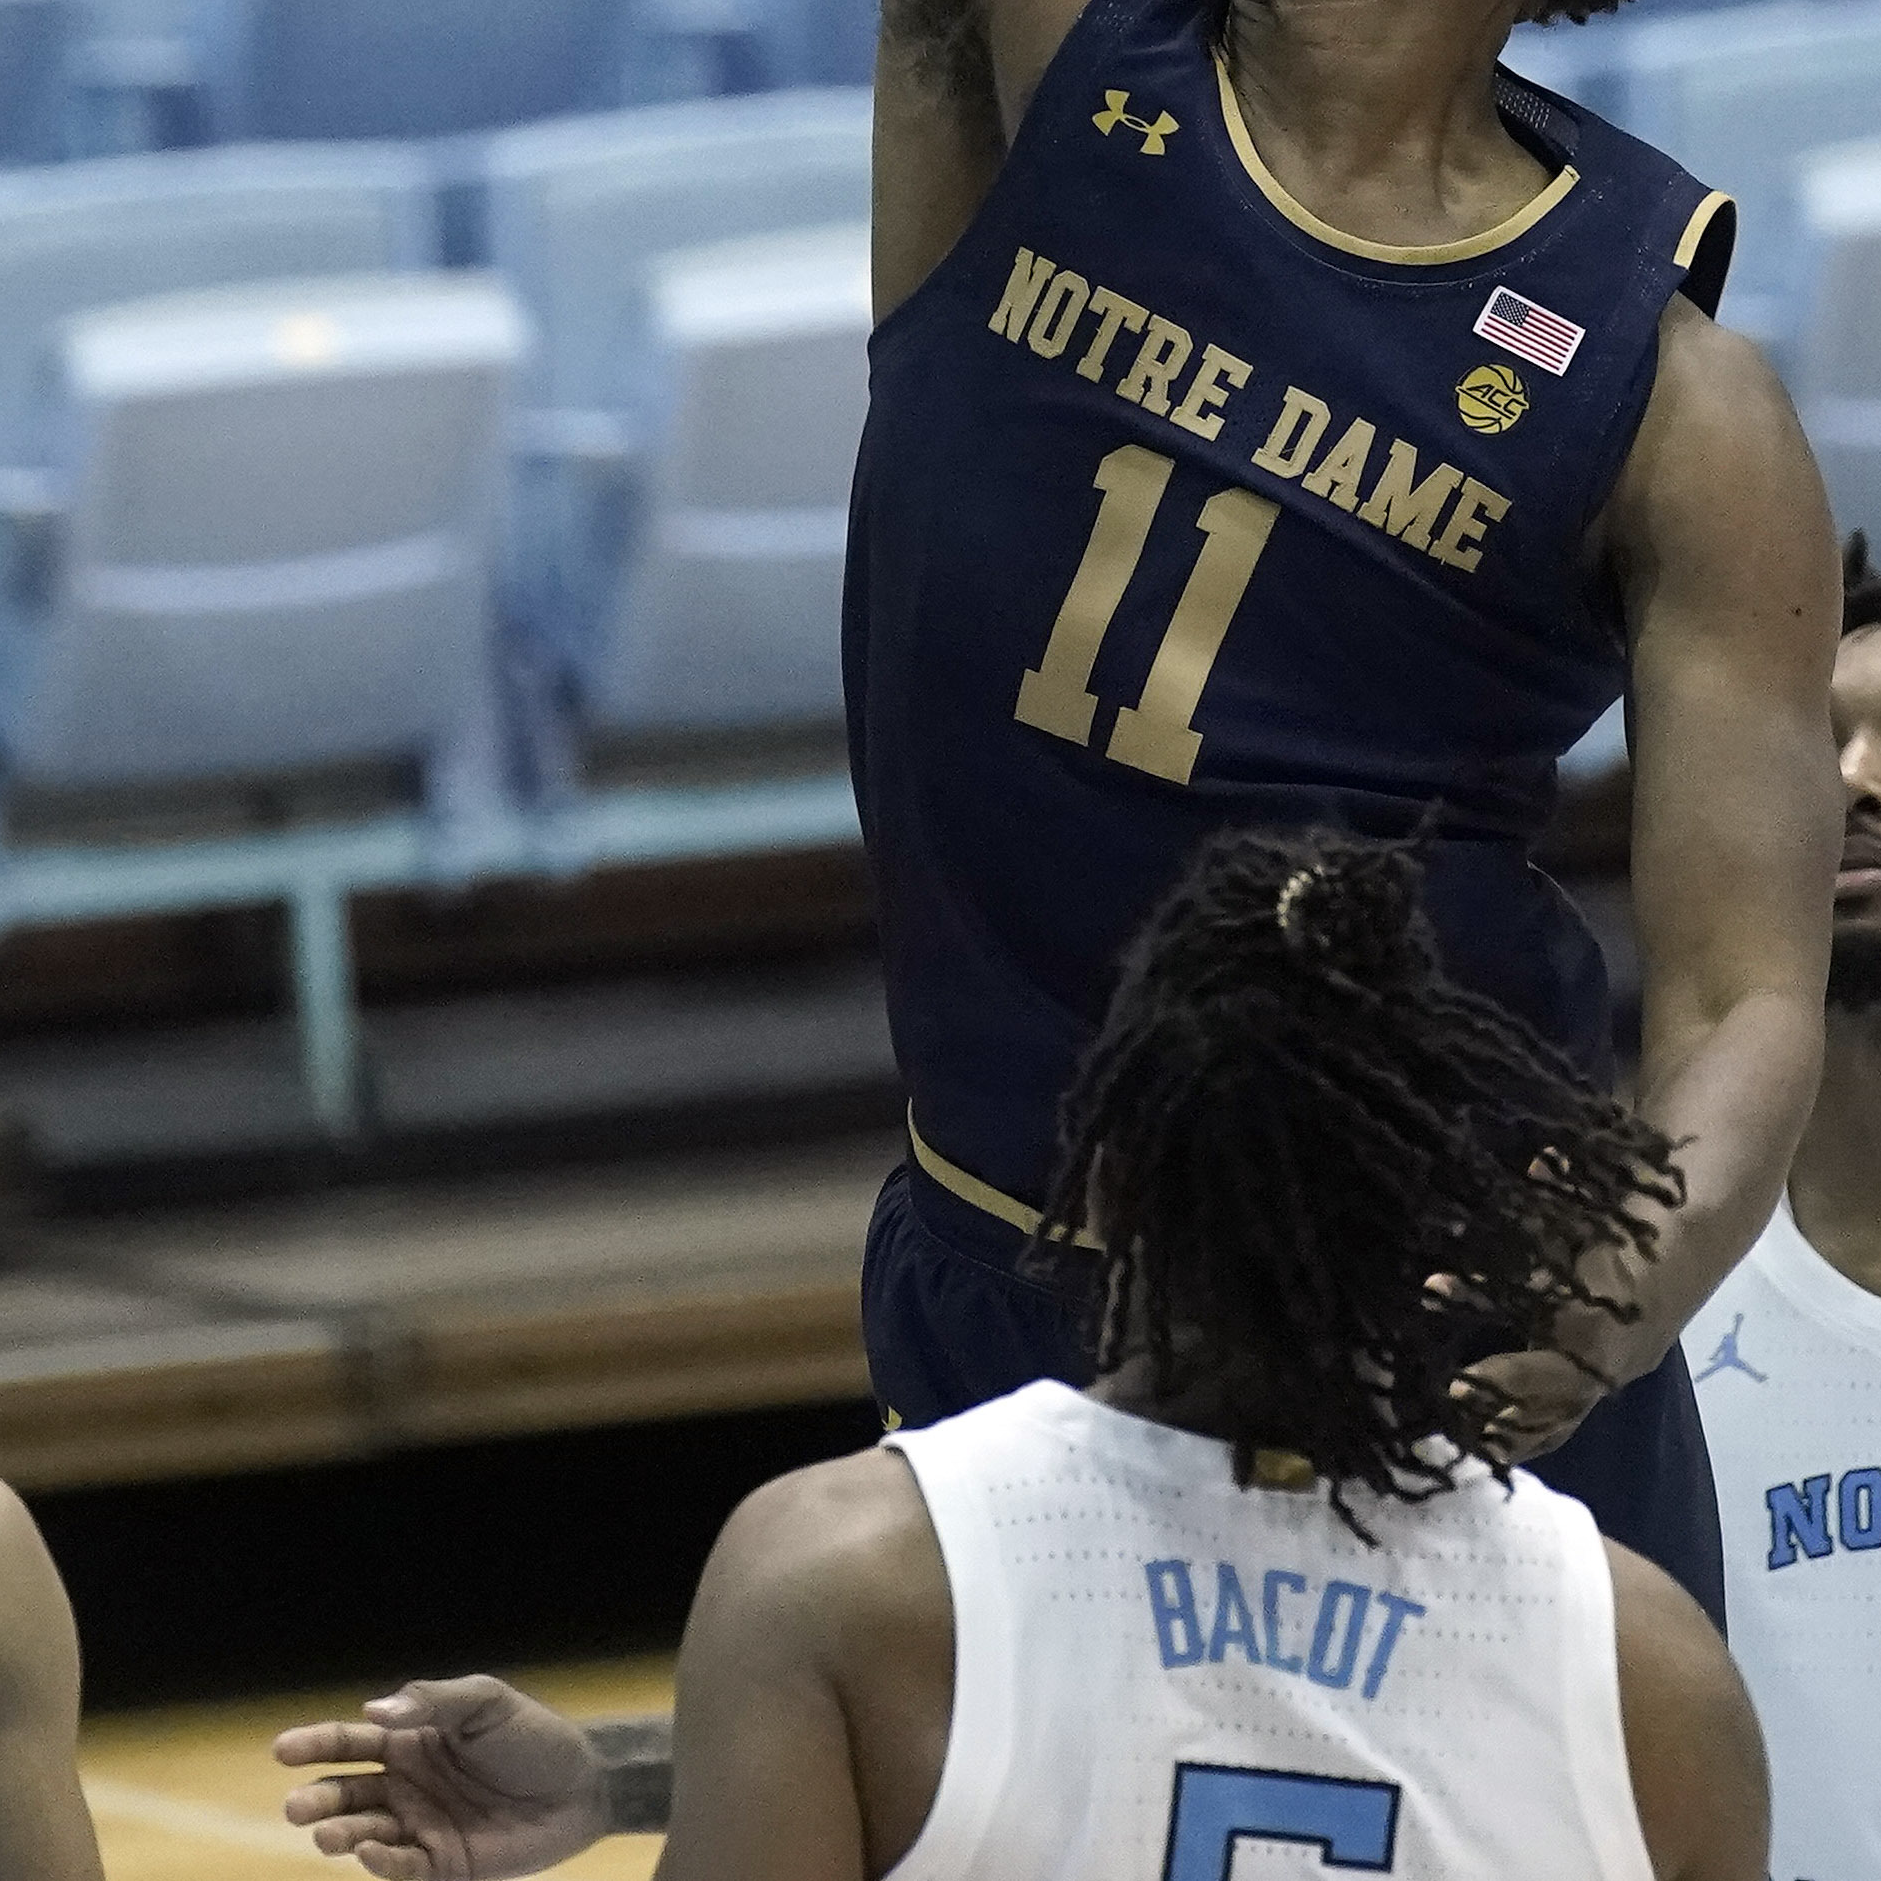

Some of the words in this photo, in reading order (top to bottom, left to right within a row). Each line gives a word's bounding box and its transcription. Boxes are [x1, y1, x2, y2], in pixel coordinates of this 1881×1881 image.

[988, 246, 1254, 442] NOTRE
[1251, 385, 1513, 573] DAME
[1465, 383, 1528, 418] ACC
[1014, 444, 1282, 786] 11
[1145, 1559, 1427, 1701] BACOT
